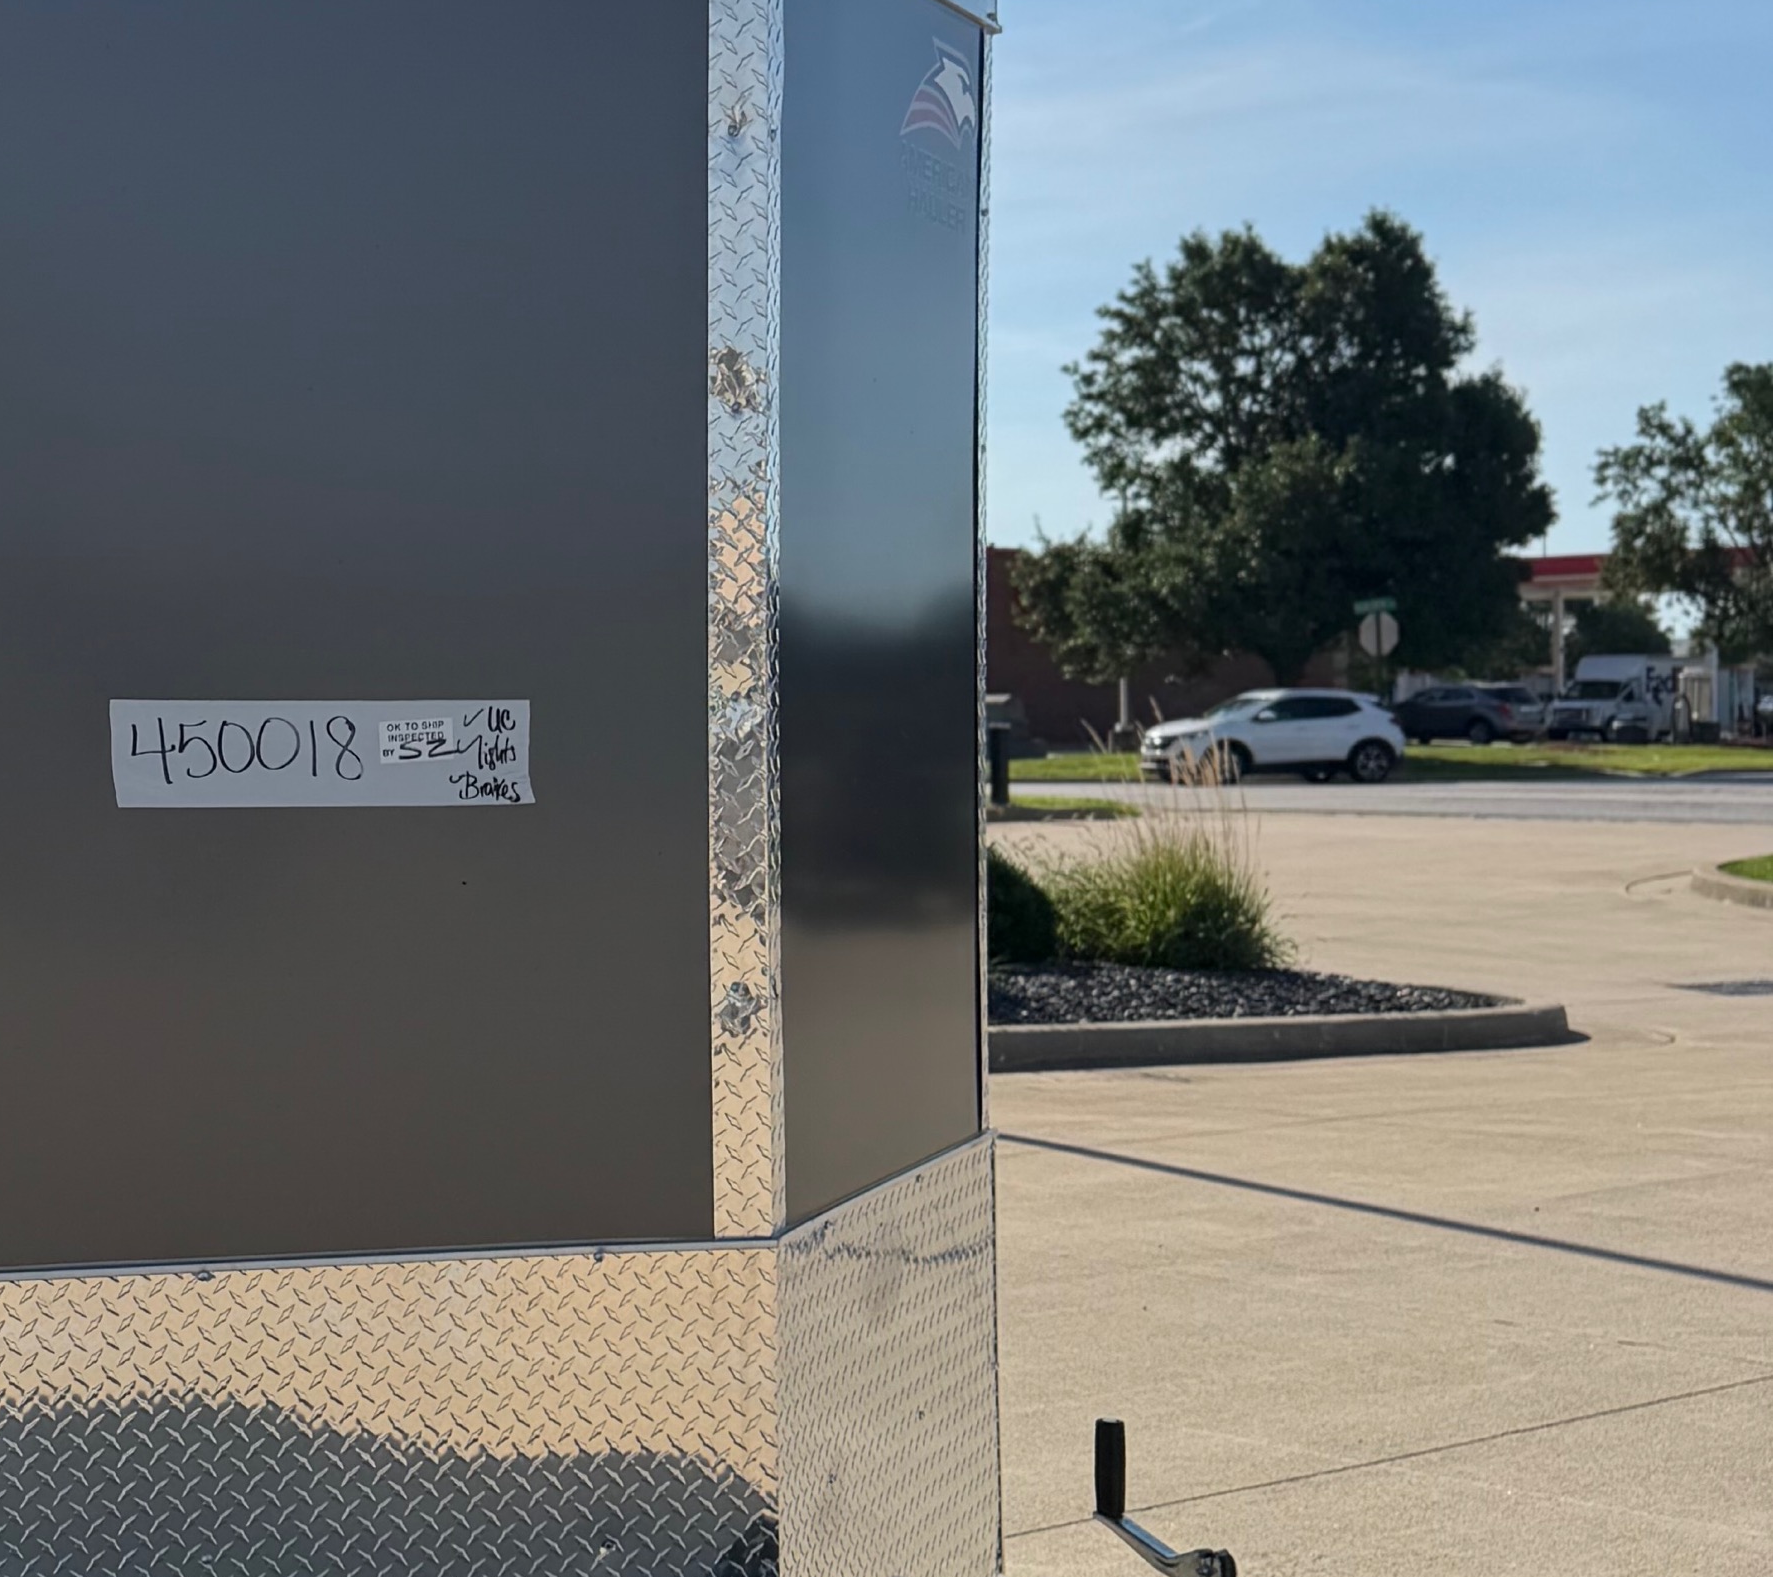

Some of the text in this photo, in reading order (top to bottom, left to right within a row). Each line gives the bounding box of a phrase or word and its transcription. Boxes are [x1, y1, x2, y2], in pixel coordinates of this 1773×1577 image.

[386, 720, 444, 732] OK TO SHIP
[388, 731, 444, 743] INSPECTED
[130, 716, 364, 785] 450018
[382, 749, 395, 758] BY
